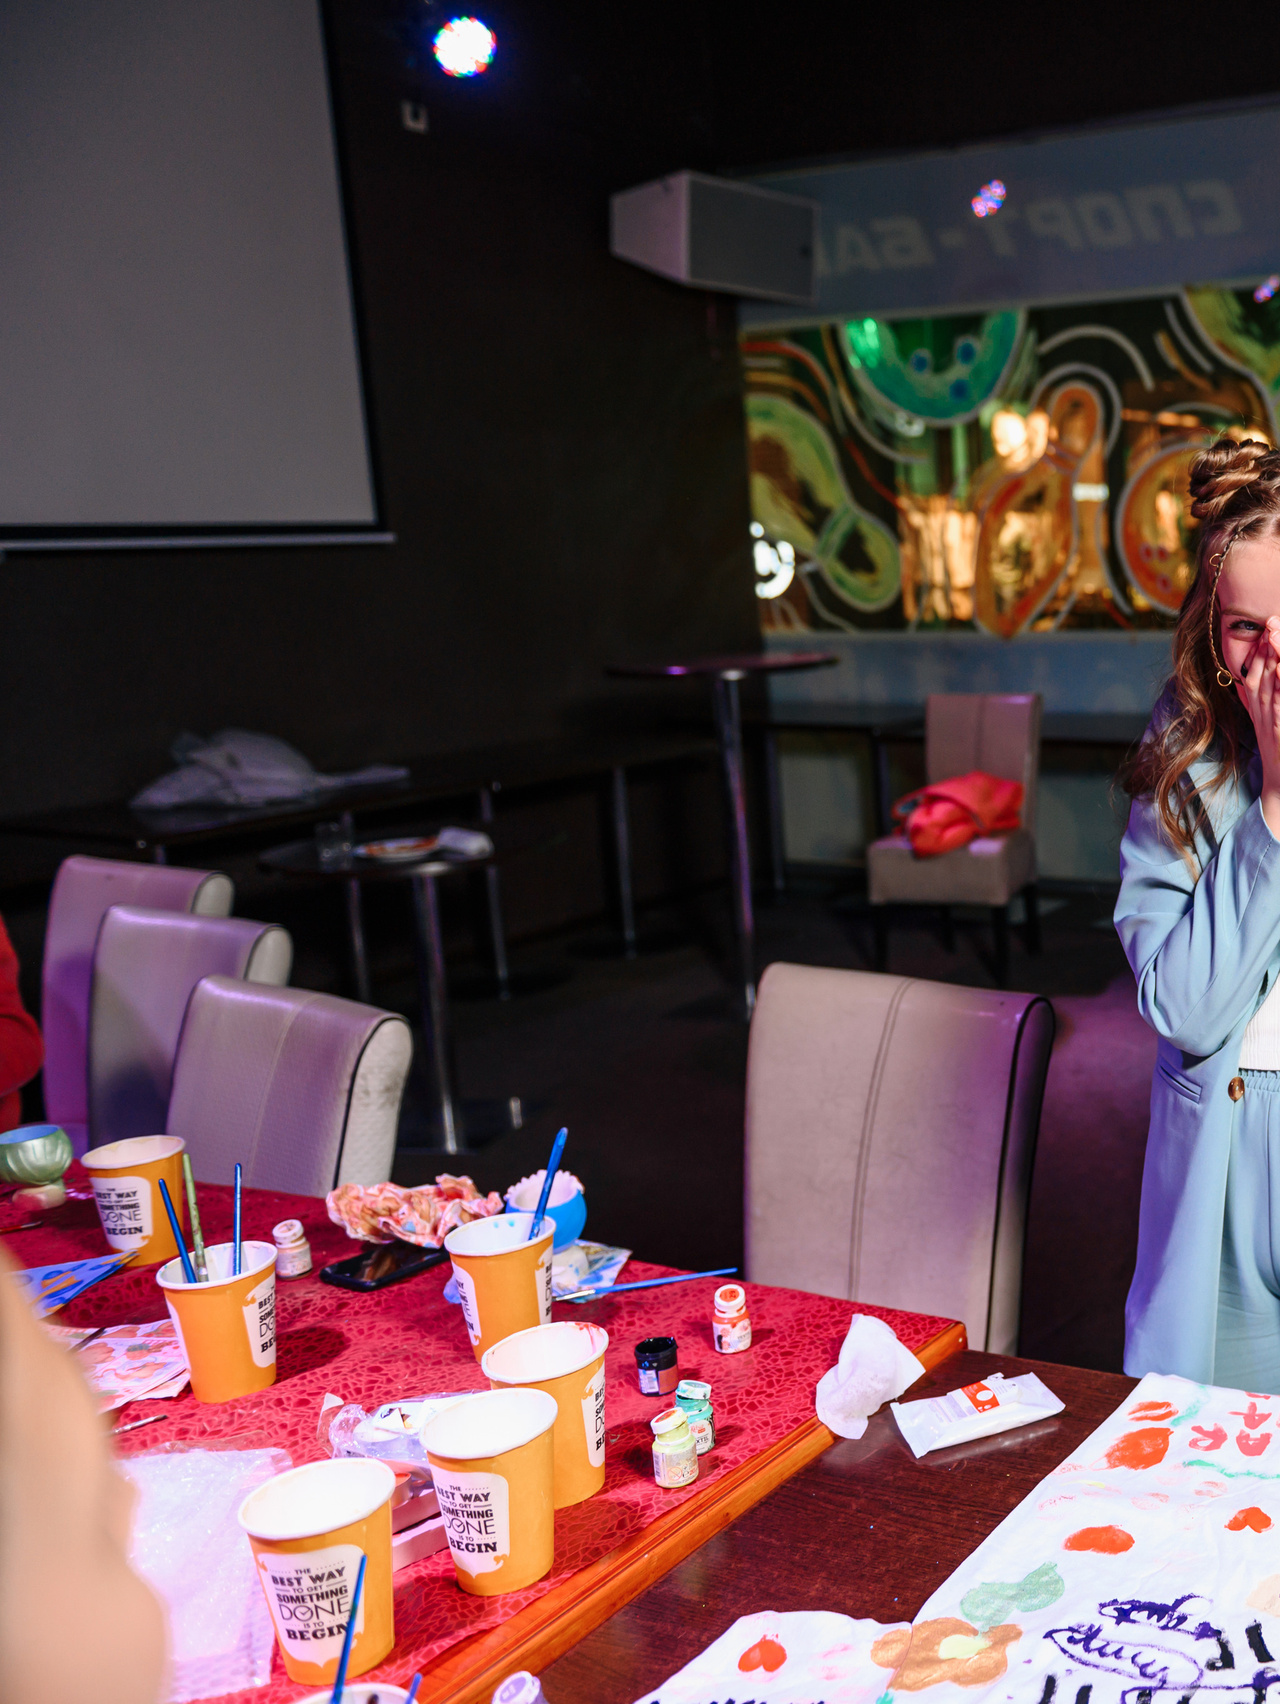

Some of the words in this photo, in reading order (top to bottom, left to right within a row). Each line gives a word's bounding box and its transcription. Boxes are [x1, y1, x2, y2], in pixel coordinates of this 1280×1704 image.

[460, 1492, 491, 1502] WAY
[443, 1512, 496, 1535] DONE
[449, 1536, 497, 1553] BEGIN
[271, 1575, 303, 1587] BEST
[309, 1566, 346, 1584] WAY
[294, 1568, 312, 1576] THE
[276, 1585, 349, 1604] SOMETHING
[279, 1595, 351, 1622] DONE
